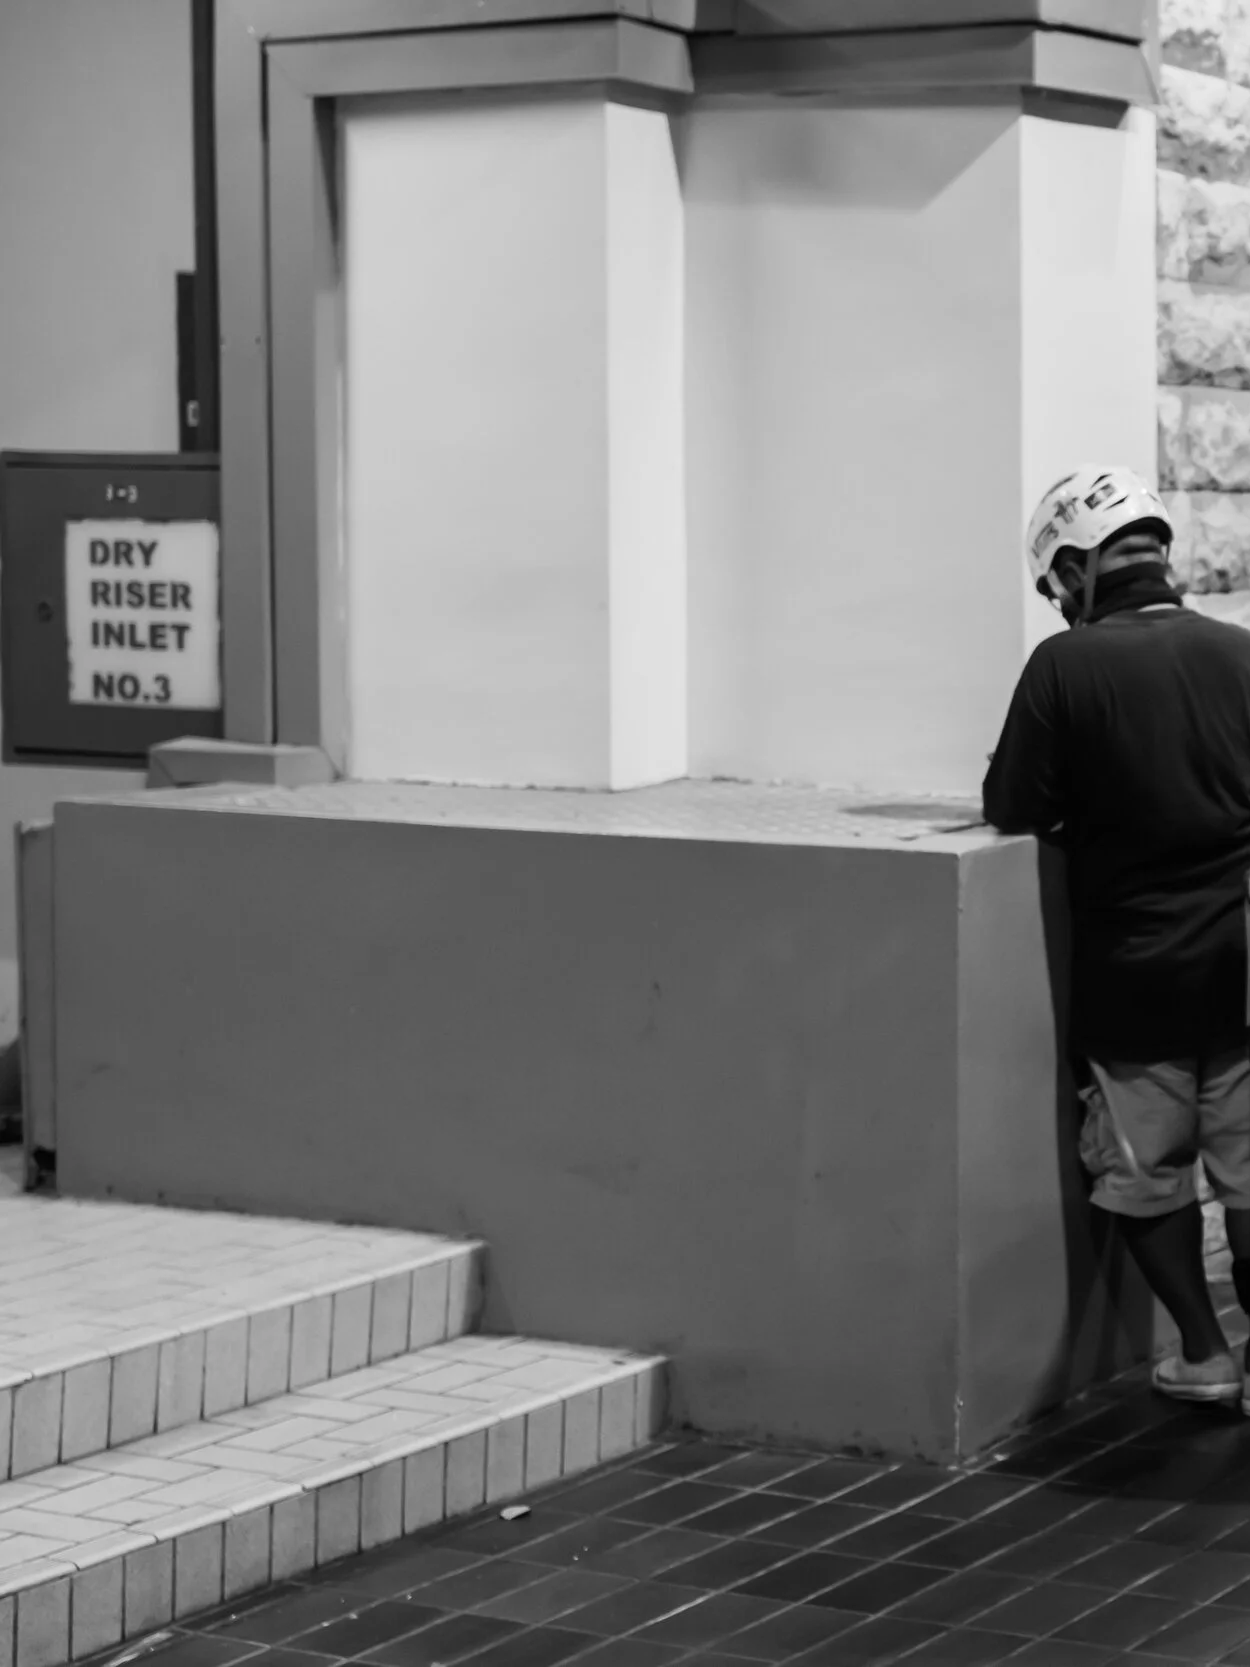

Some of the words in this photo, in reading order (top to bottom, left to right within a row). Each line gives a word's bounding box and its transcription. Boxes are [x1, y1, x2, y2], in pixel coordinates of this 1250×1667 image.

[89, 539, 158, 567] DRY
[90, 580, 192, 610] RISER
[92, 621, 191, 651] INLET
[93, 671, 171, 703] NO.3
